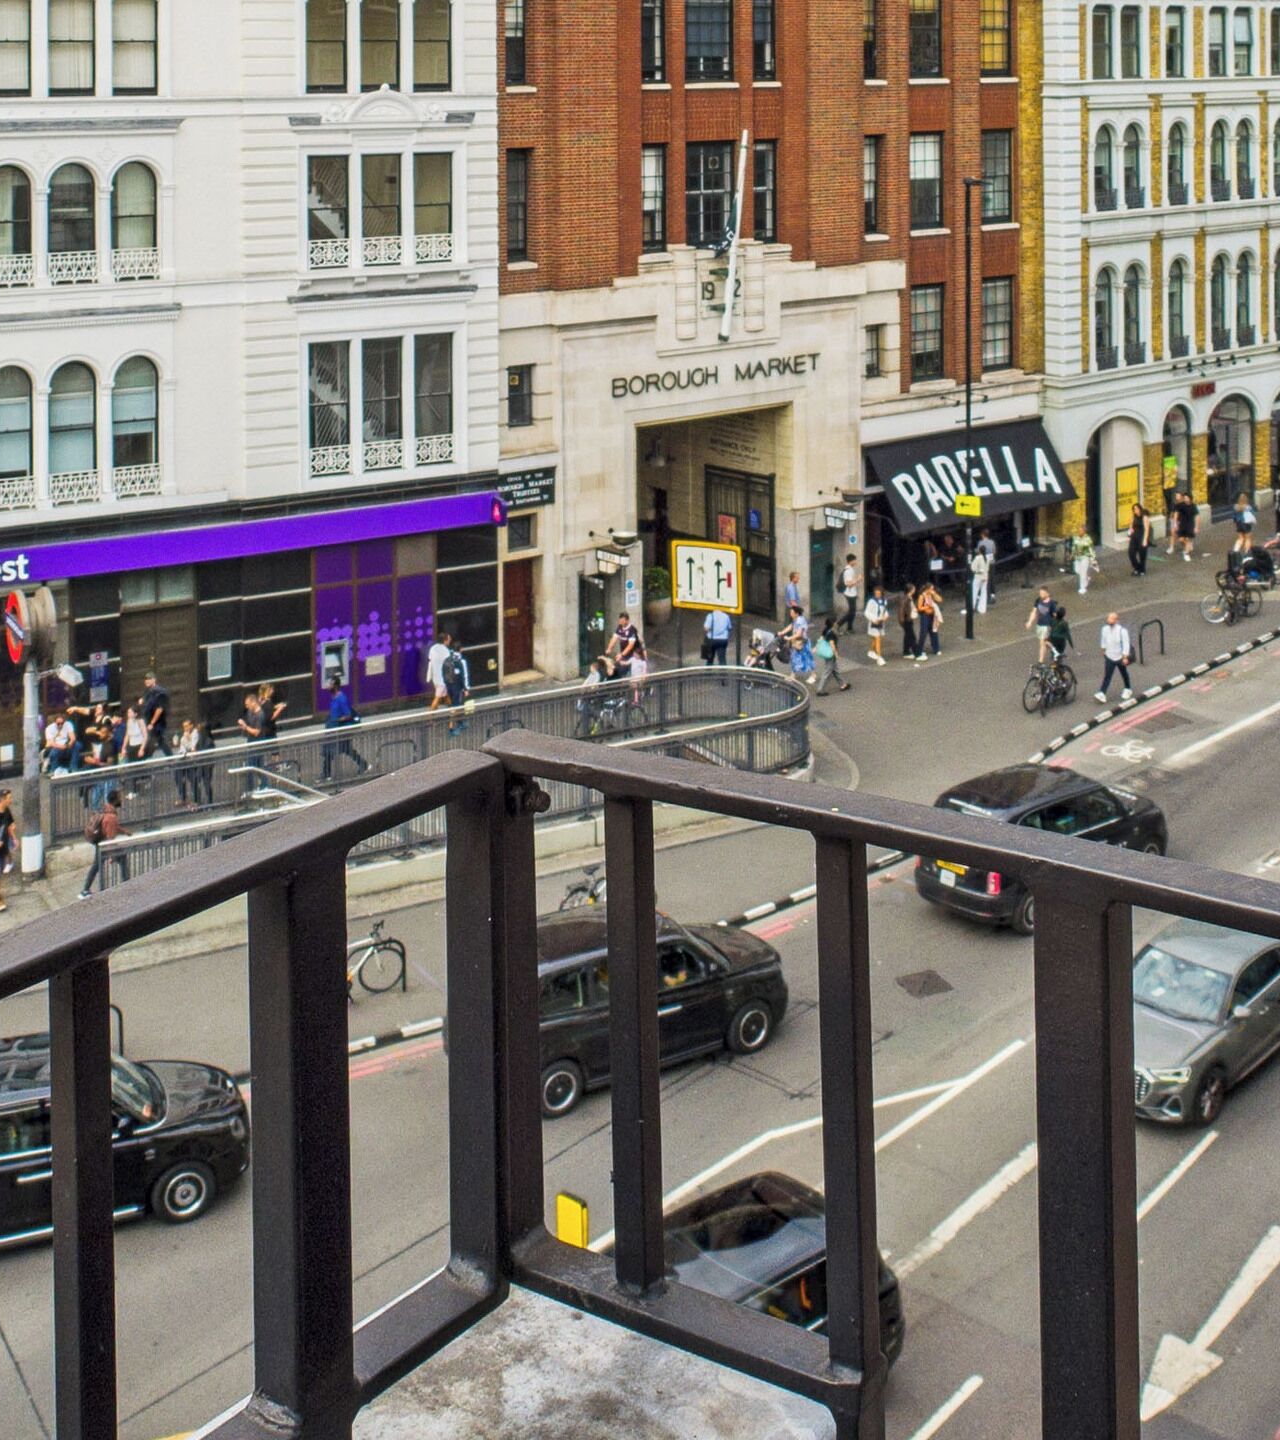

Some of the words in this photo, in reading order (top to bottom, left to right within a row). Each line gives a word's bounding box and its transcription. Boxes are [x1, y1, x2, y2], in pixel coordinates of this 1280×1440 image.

[611, 365, 719, 399] BOROUGH
[734, 352, 822, 382] MARKET
[891, 445, 1063, 523] PADELLA
